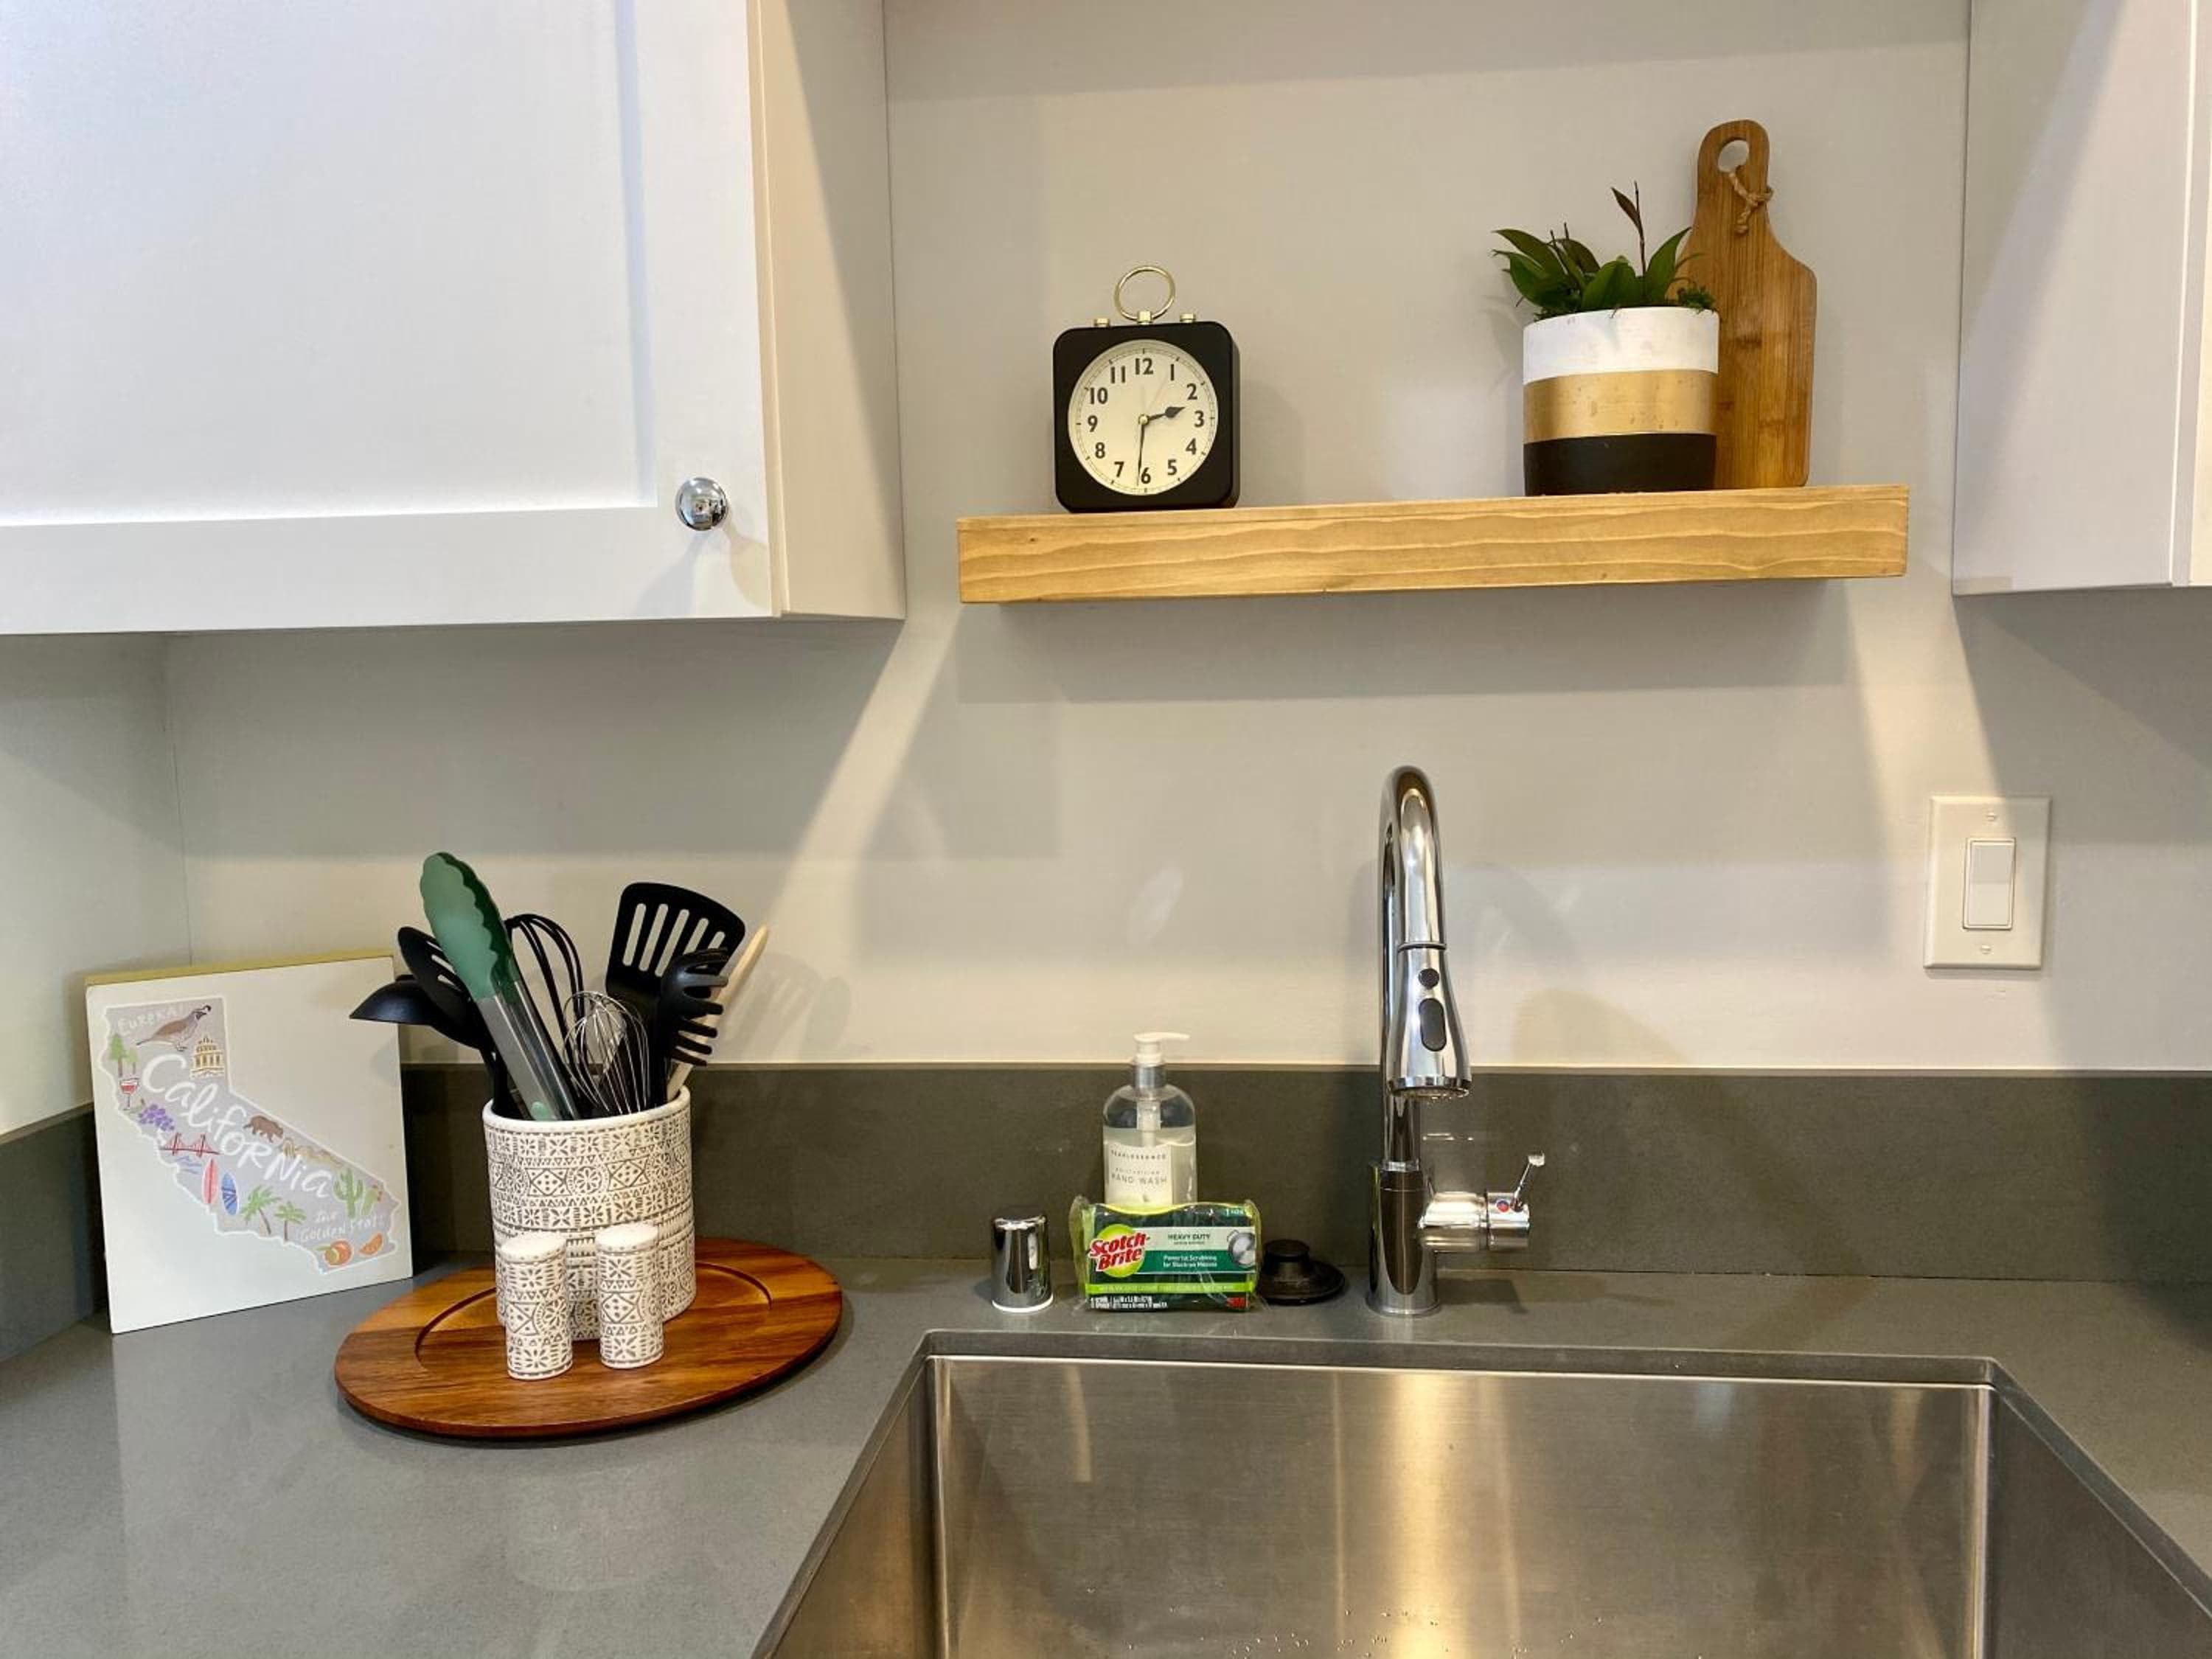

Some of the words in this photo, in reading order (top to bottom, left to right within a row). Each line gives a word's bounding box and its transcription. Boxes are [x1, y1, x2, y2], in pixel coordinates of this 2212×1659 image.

[1110, 366, 1126, 383] 11
[1135, 358, 1154, 375] 12
[1170, 364, 1175, 381] 1
[1089, 387, 1108, 405] 10
[1186, 383, 1198, 400] 2
[1088, 415, 1098, 432] 9
[1194, 410, 1205, 428] 3
[1095, 442, 1105, 459] 8
[1186, 438, 1197, 455] 4
[1114, 462, 1124, 478] 7
[1141, 467, 1151, 484] 6
[1167, 459, 1178, 476] 5
[1097, 1248, 1143, 1270] Brite
